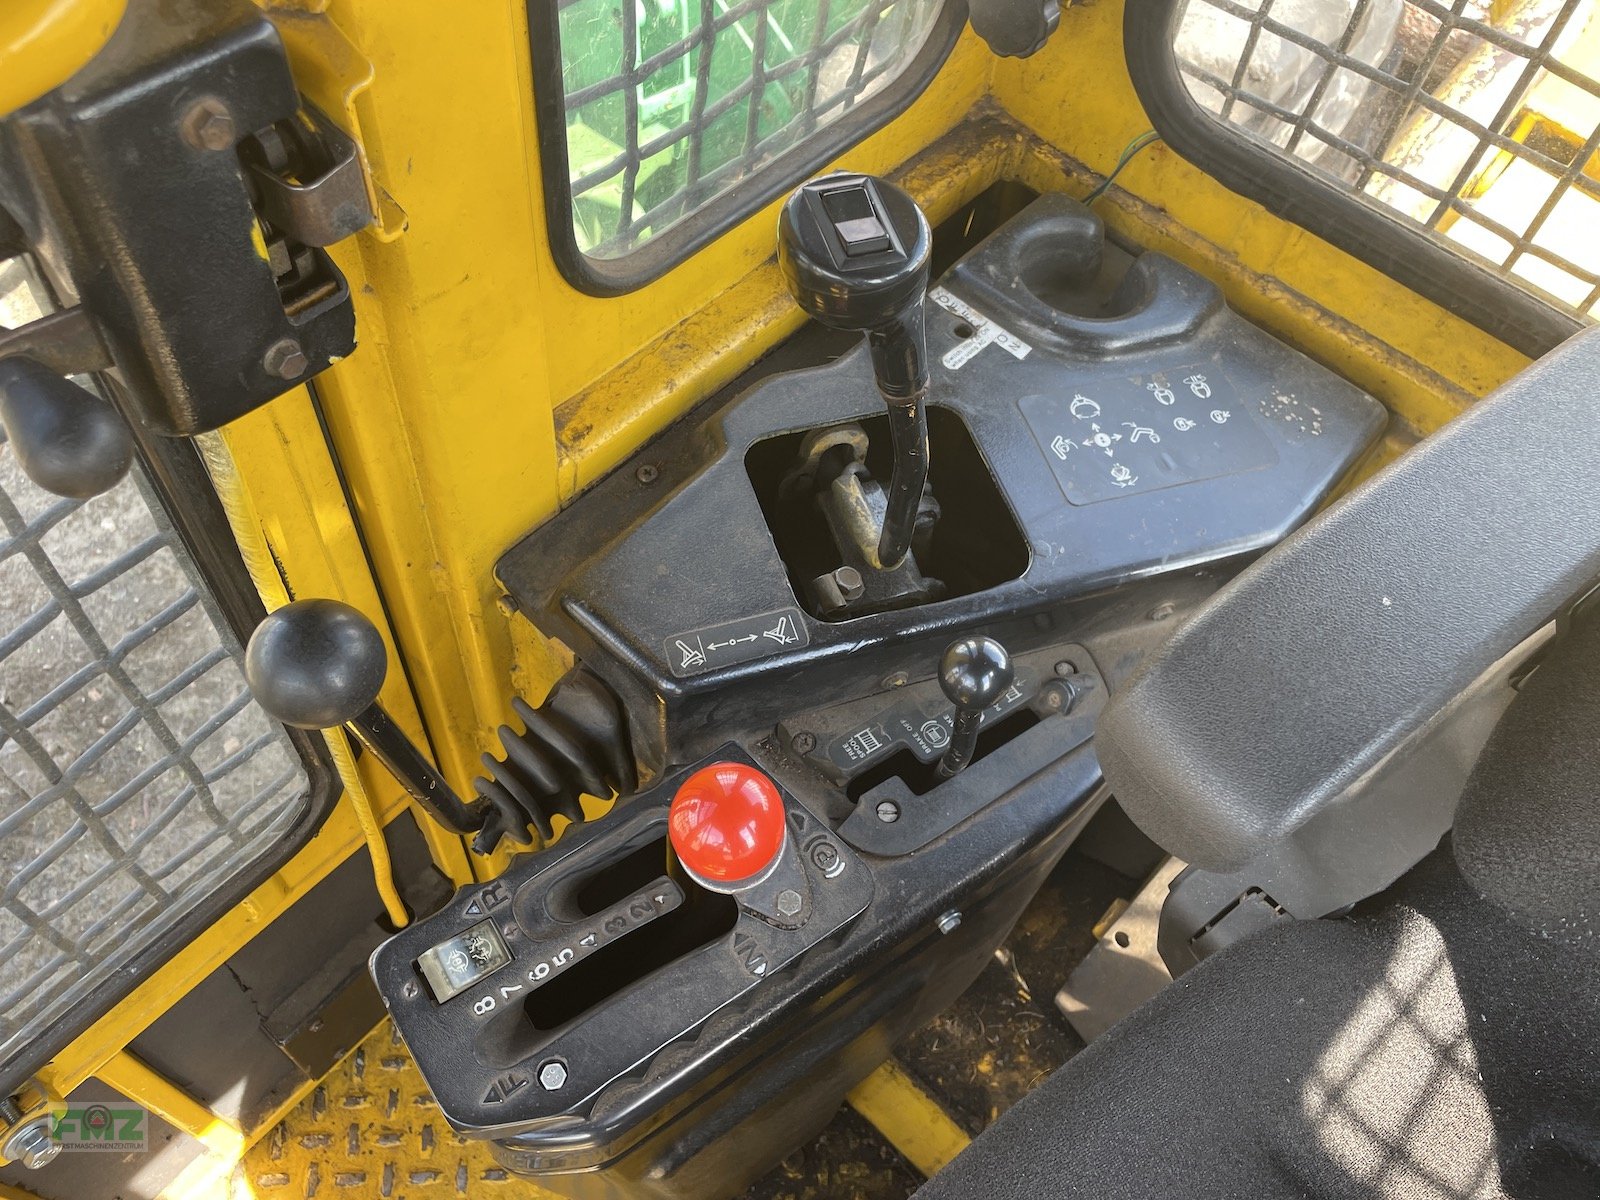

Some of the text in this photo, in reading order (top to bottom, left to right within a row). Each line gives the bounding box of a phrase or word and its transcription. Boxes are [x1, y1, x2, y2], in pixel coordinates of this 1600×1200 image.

[996, 333, 1021, 352] ON
[900, 720, 932, 754] BRAKE OFF
[842, 742, 857, 760] FREE
[848, 737, 866, 759] SPOOL
[481, 884, 508, 911] R
[630, 899, 653, 919] 2
[604, 916, 626, 934] 3
[579, 932, 598, 948] 4
[552, 948, 574, 967] 5
[528, 962, 550, 982] 6
[501, 984, 523, 999] 7
[473, 995, 496, 1016] 8
[498, 1074, 528, 1098] F
